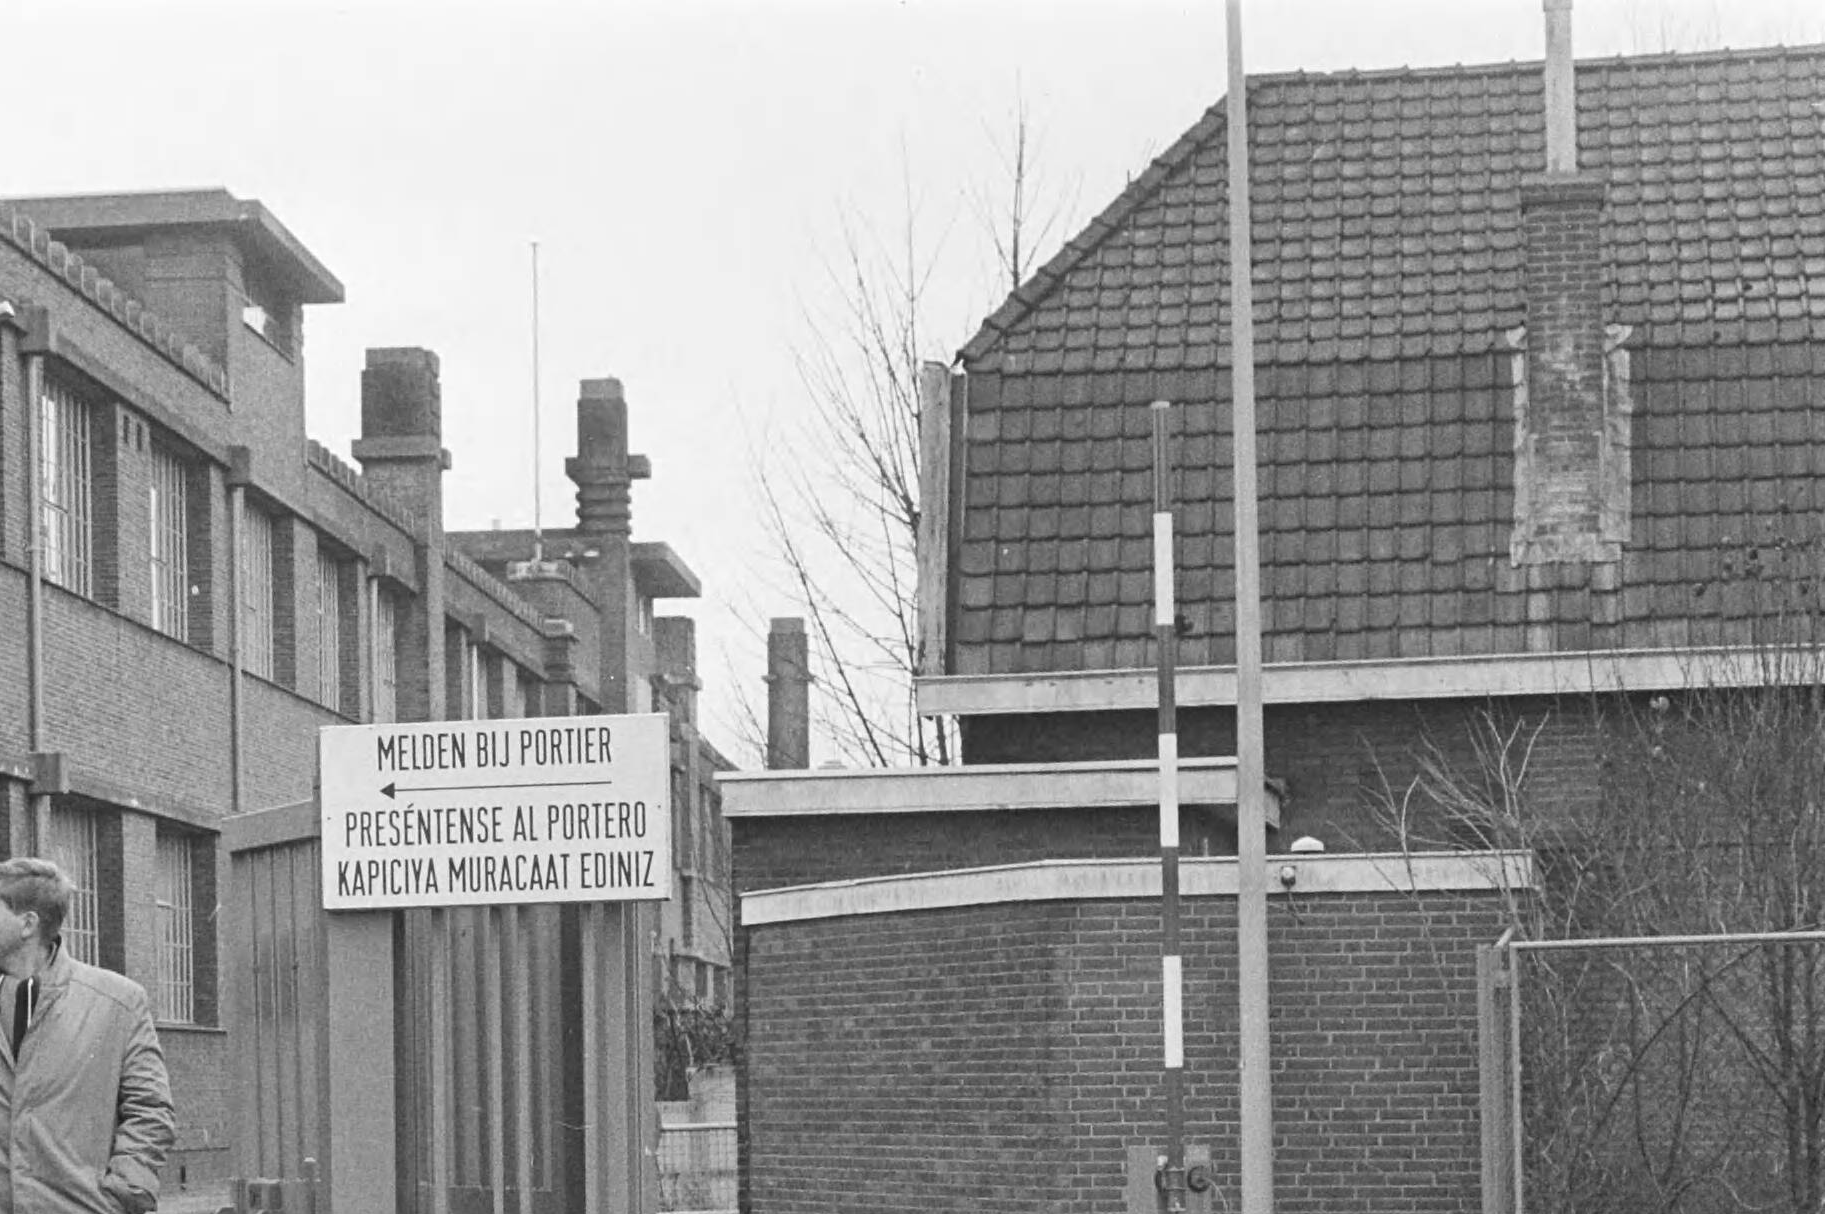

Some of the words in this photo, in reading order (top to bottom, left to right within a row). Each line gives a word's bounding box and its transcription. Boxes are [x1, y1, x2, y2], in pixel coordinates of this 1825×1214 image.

[378, 732, 465, 771] MELDEN
[477, 731, 510, 768] BIJ
[521, 728, 612, 766] PORTIER
[346, 803, 503, 847] PRESÉNTENSE
[514, 806, 538, 841] AL
[548, 802, 646, 840] PORTERO
[339, 858, 438, 896] KAPICIYA
[449, 854, 569, 892] MURACAAT
[581, 851, 654, 888] EDINIZ
